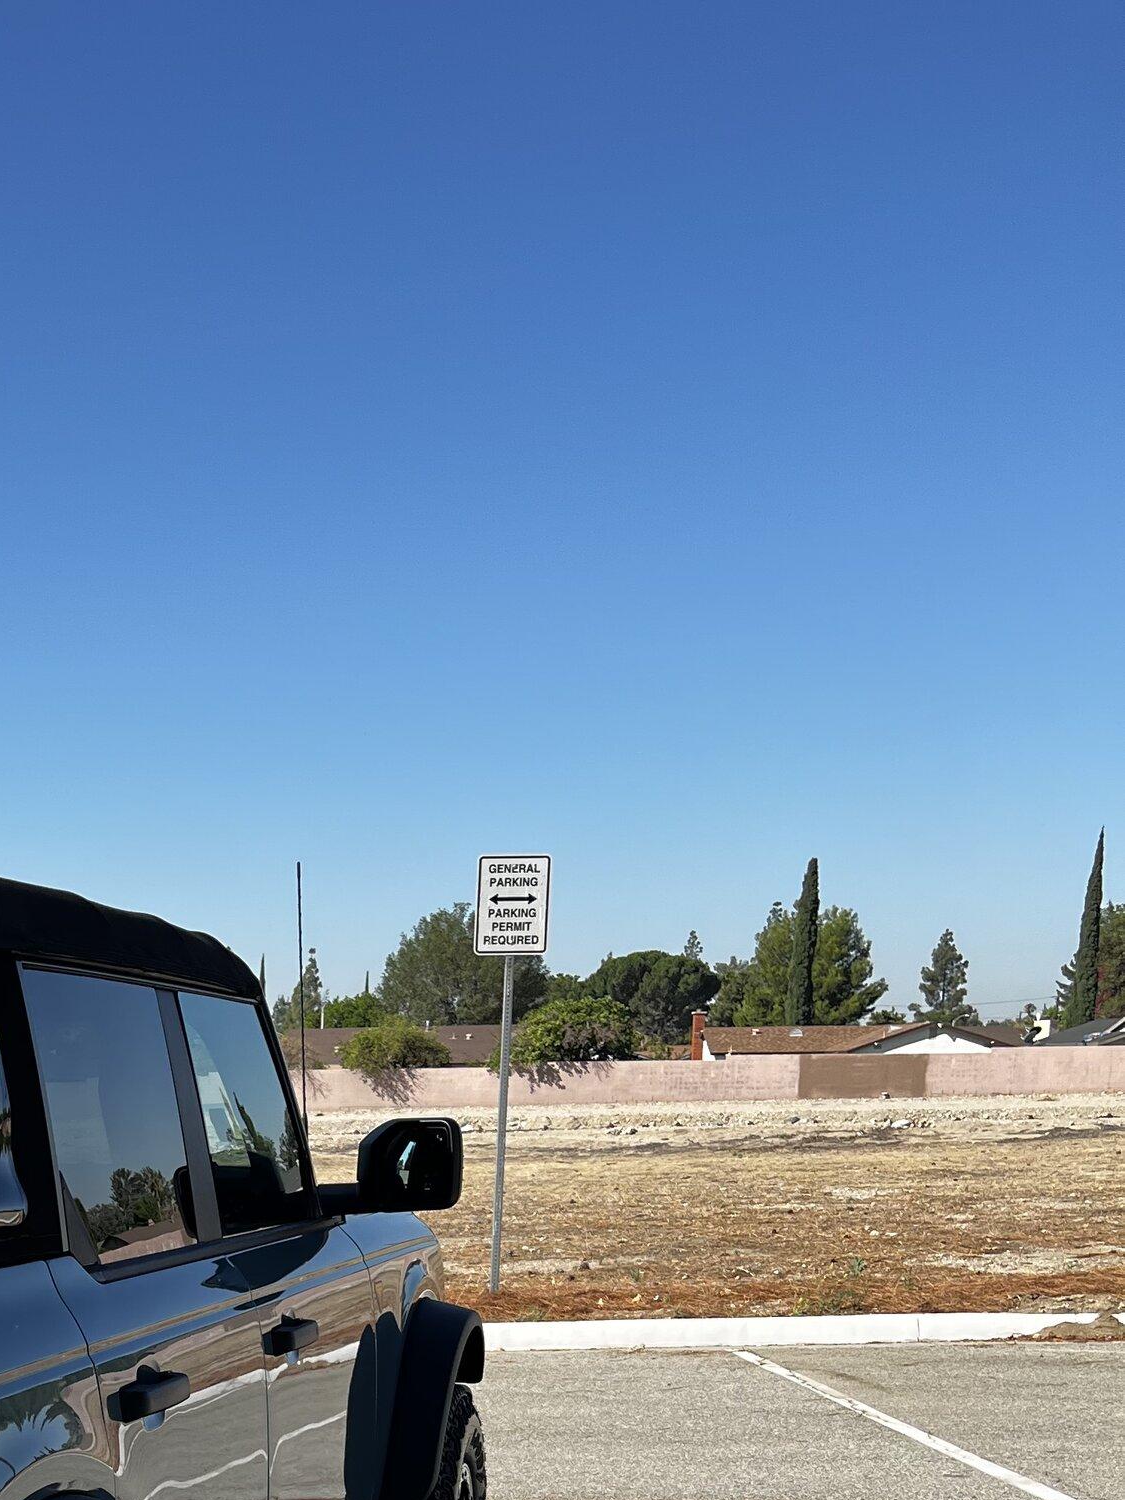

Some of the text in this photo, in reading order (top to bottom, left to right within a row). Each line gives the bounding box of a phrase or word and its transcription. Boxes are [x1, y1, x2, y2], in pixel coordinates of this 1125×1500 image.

[488, 863, 541, 874] GENERAL
[489, 877, 539, 887] PARKING
[487, 908, 537, 918] PARKING
[491, 921, 532, 931] PERMIT
[483, 935, 539, 945] REQUIRED
